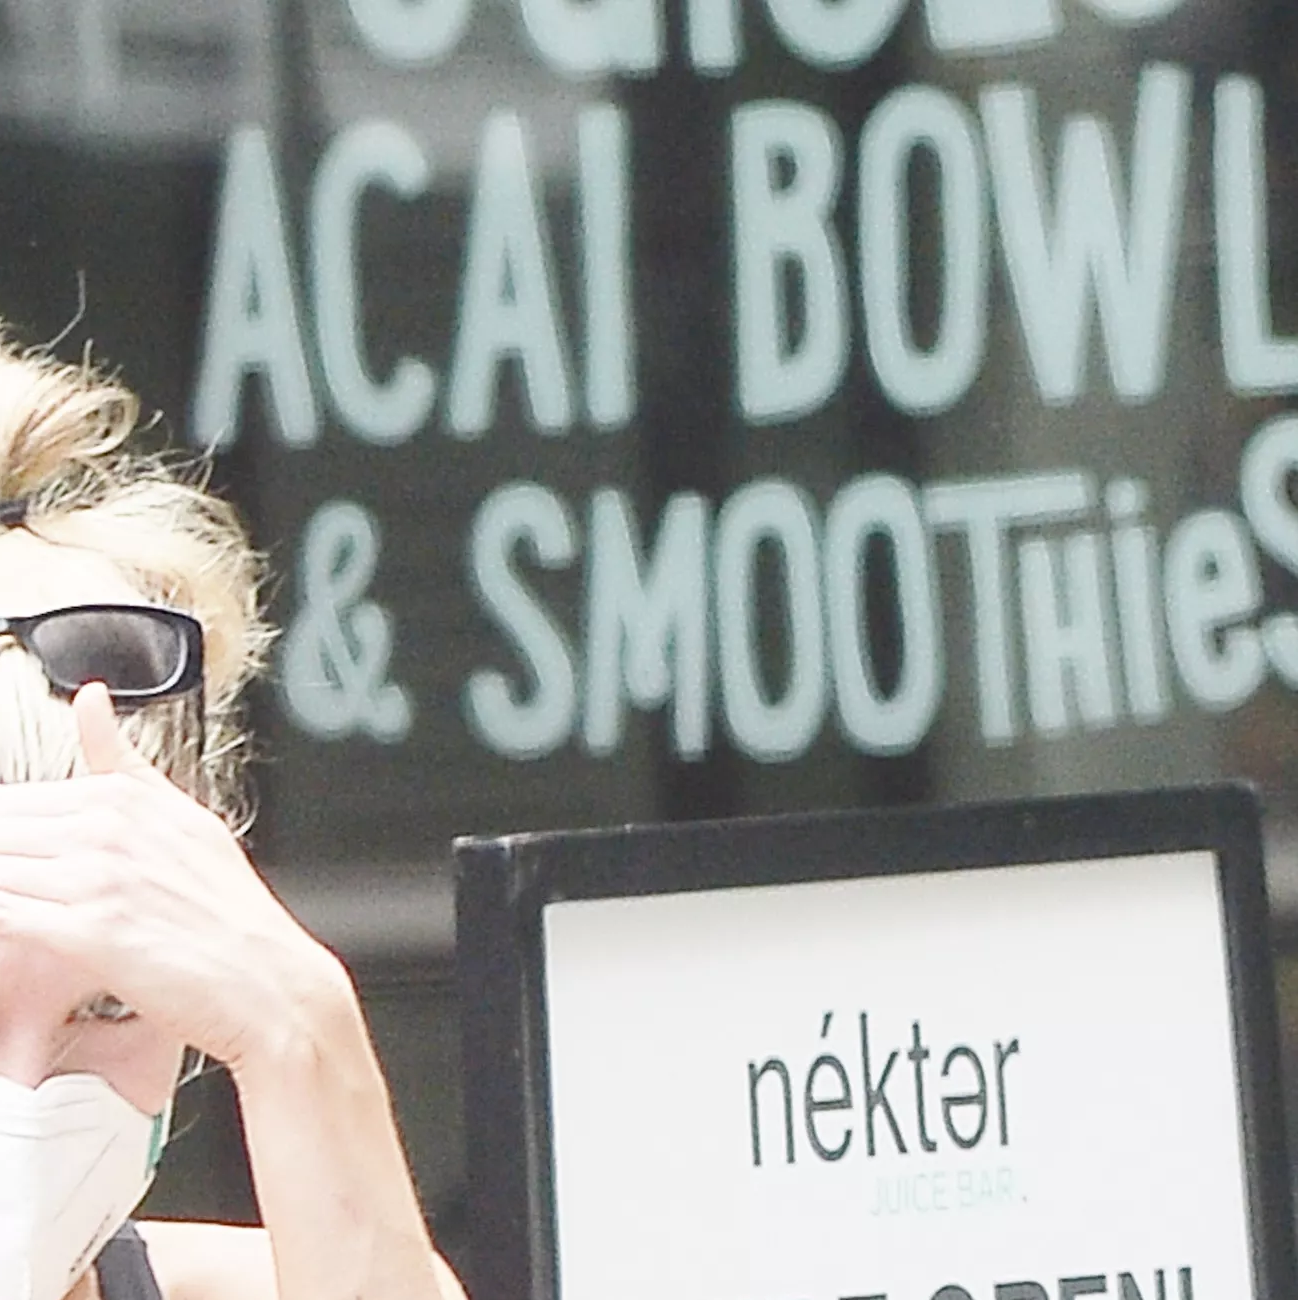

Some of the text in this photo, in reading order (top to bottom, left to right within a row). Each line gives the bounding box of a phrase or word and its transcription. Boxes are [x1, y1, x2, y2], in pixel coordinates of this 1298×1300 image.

[190, 102, 636, 446] ACAI
[283, 501, 414, 744] &
[869, 1172, 951, 1217] JUICE
